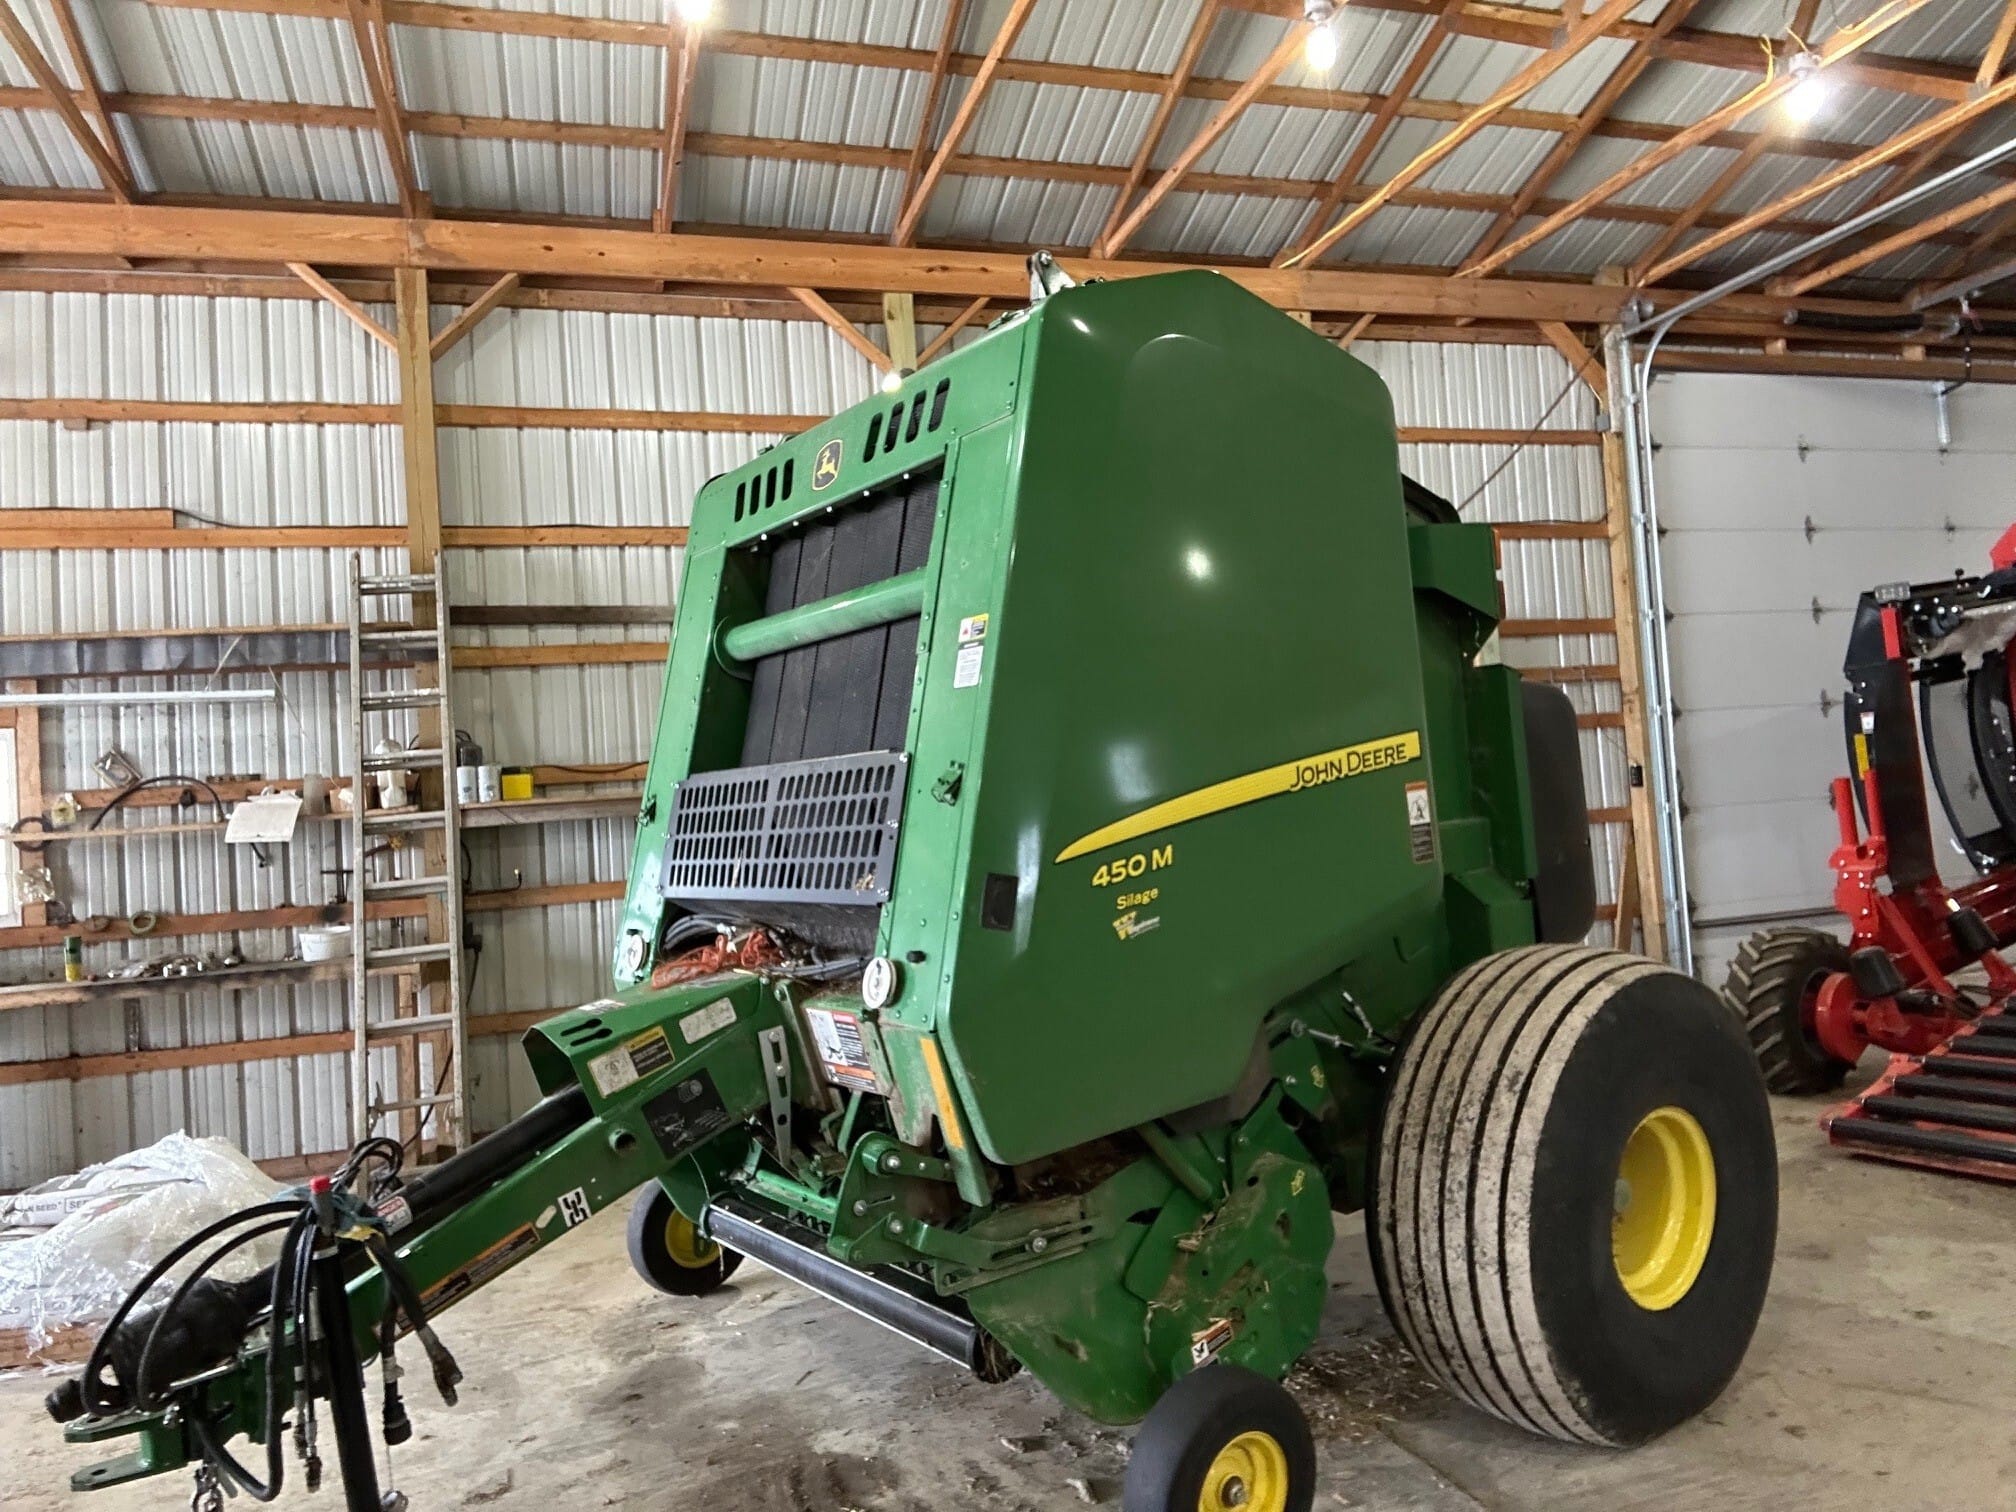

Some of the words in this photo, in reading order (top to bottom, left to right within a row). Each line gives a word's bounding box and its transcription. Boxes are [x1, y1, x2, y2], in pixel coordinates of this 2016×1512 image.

[1290, 758, 1343, 789] JOHN
[1346, 742, 1408, 774] DEERE
[1091, 853, 1147, 887] 450
[1151, 843, 1174, 871] M
[1115, 887, 1160, 910] Silage
